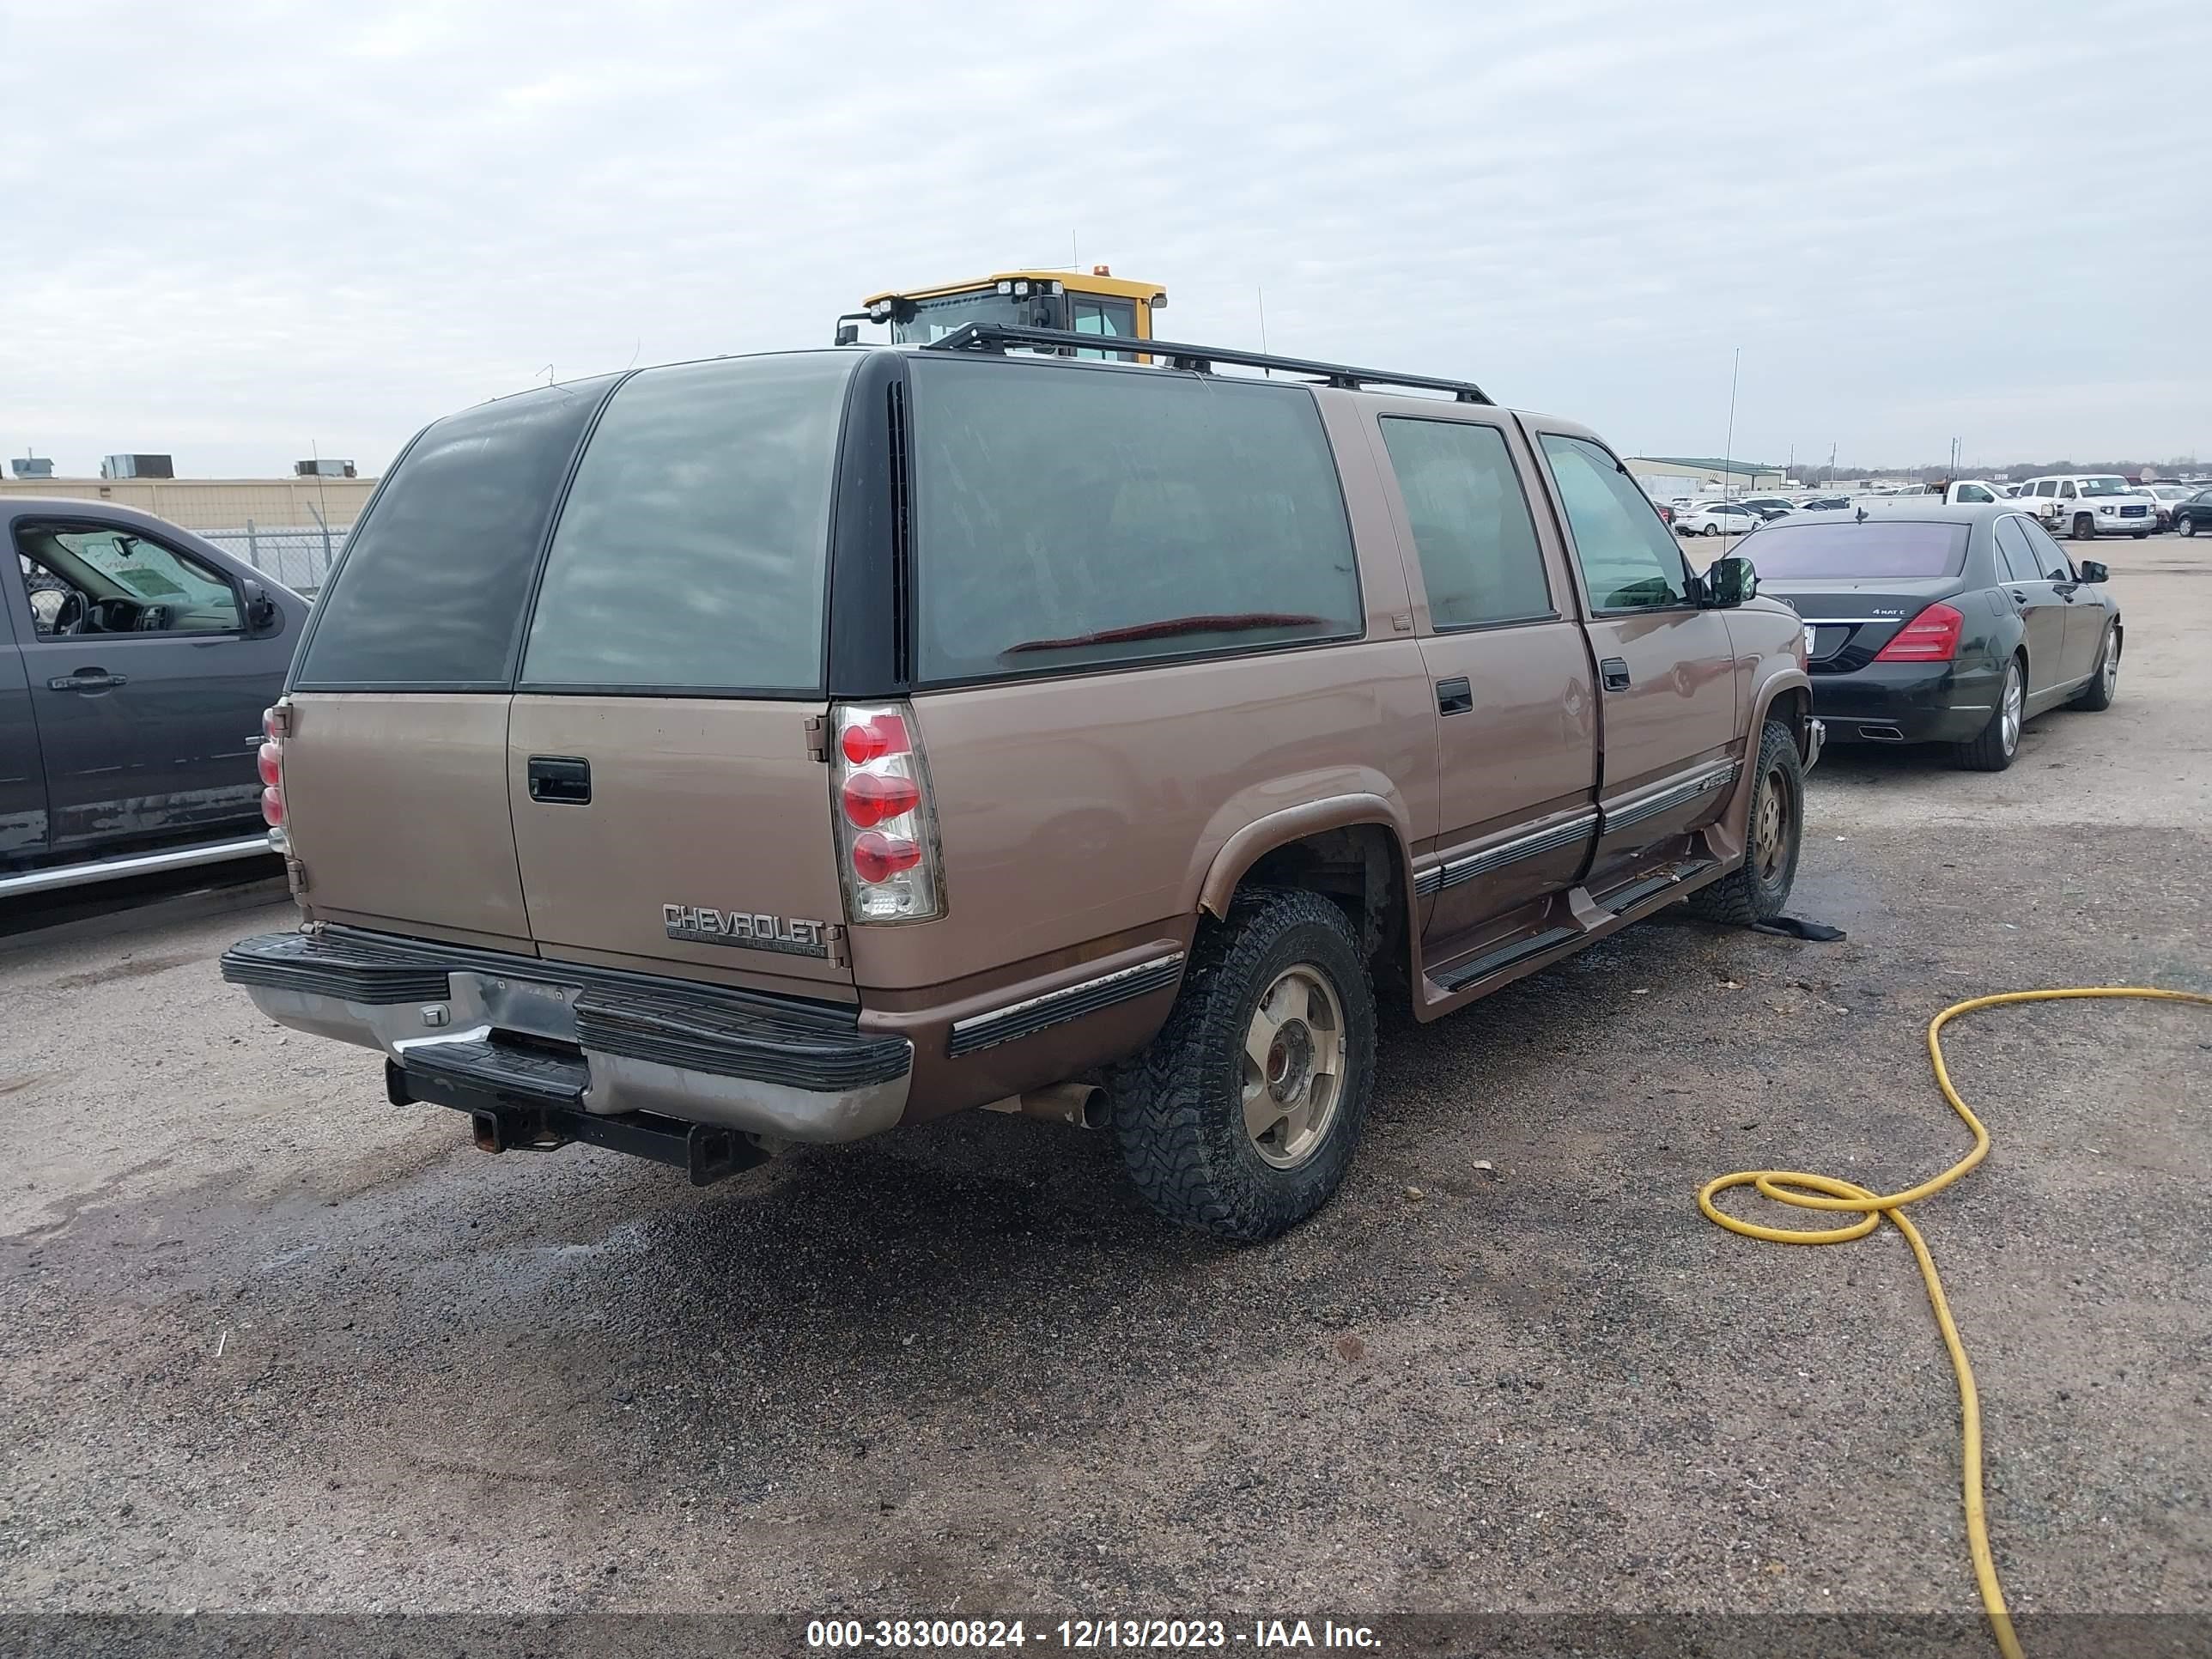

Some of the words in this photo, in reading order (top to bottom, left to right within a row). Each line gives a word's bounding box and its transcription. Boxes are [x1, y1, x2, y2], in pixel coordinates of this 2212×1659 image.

[663, 902, 826, 945] CHEVROLET
[746, 939, 771, 949] FUEL
[772, 942, 824, 957] INJECTION
